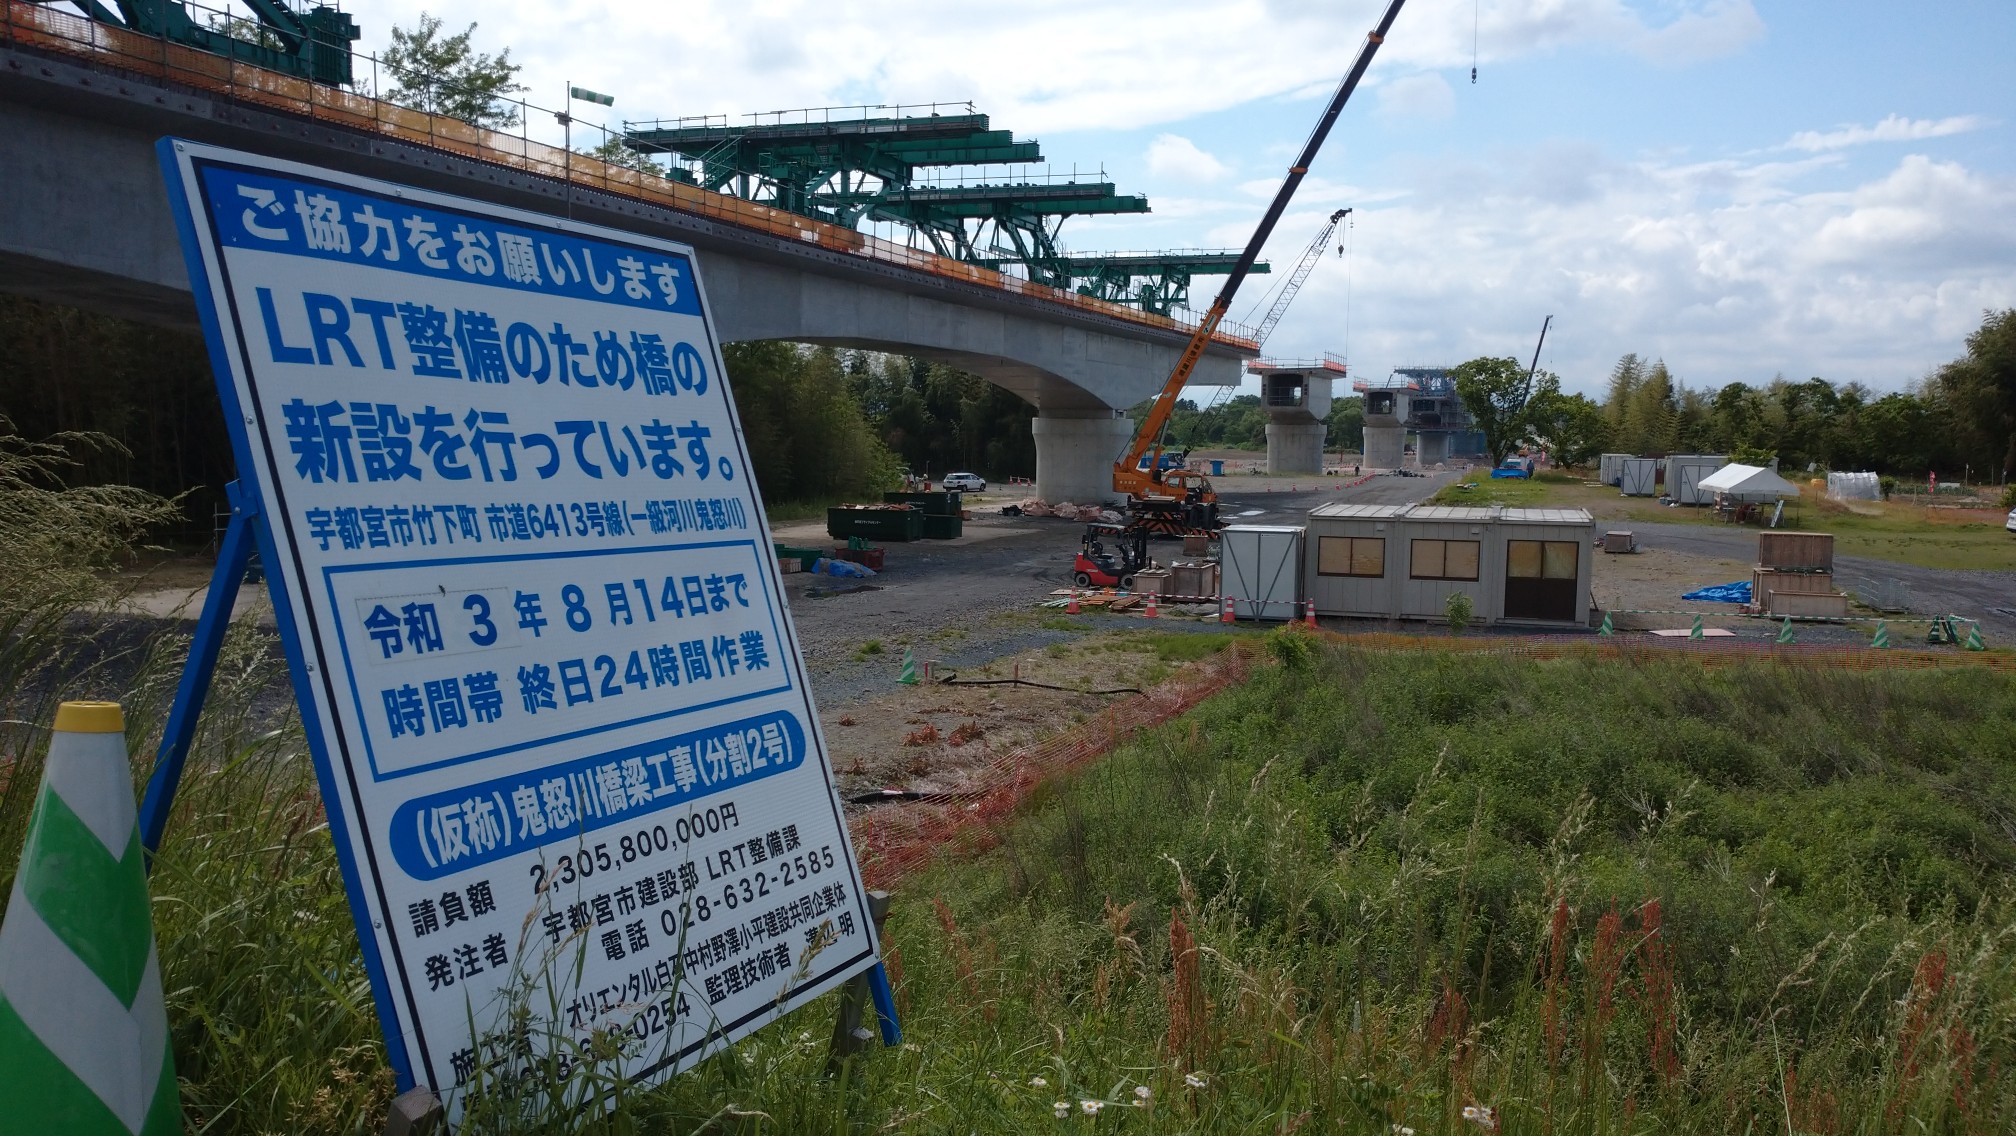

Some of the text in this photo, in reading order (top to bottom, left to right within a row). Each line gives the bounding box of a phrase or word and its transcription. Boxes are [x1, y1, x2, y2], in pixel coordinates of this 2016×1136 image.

[236, 184, 680, 306] ご協力をお願いします
[255, 287, 708, 396] LRT整備のため橋の
[282, 398, 734, 484] 新設を行っています。
[305, 503, 482, 551] 宇都宮市竹下町
[364, 603, 445, 659] 令和
[463, 594, 498, 647] 3
[382, 629, 770, 739] 時間帯 終日24時間作業
[408, 802, 739, 938] 請負額 2,305,800,000円
[424, 824, 801, 992] 発注者 宇都宮市建設部 LRT整備課
[601, 919, 650, 961] 電話
[661, 845, 835, 936] 028-632-2585
[704, 942, 792, 1006] 監理技術者
